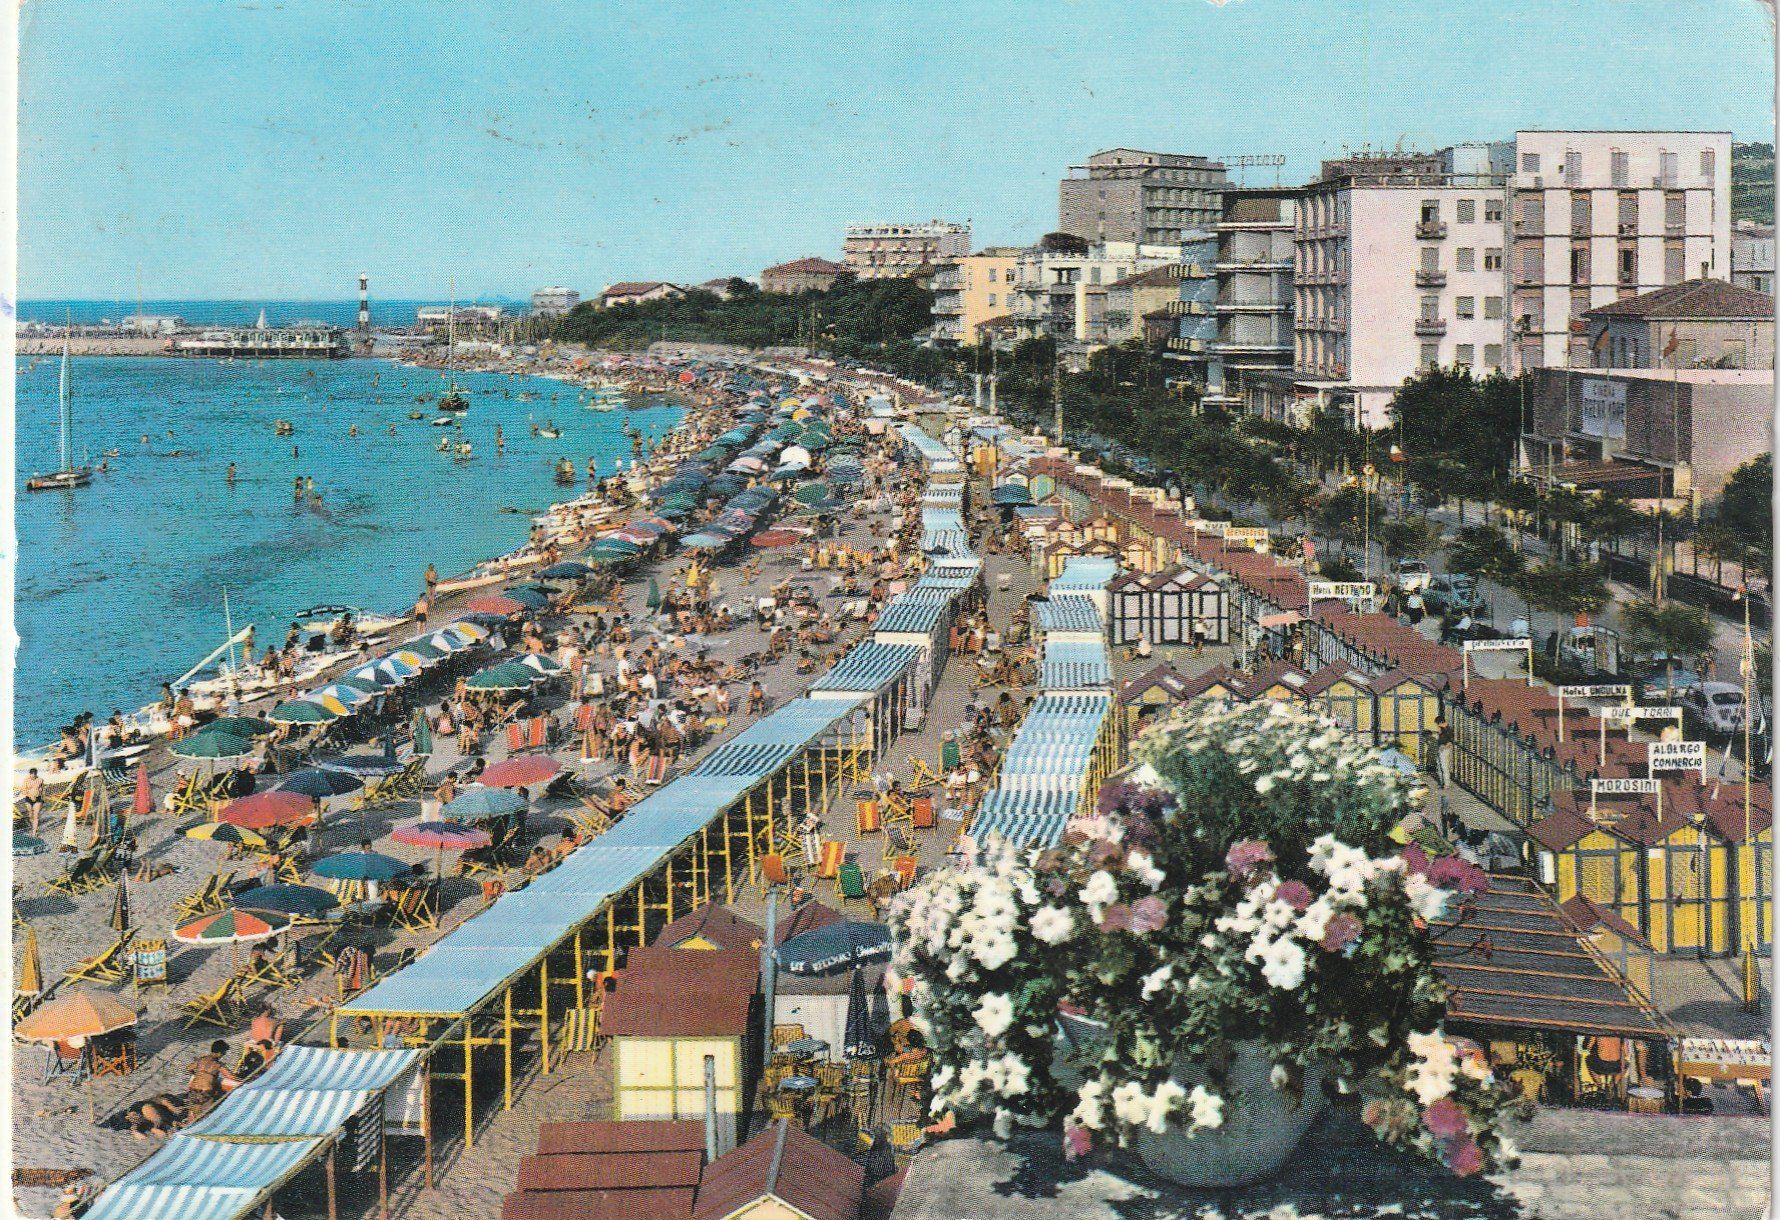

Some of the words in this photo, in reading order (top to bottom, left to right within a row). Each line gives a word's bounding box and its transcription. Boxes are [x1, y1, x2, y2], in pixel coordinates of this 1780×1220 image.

[1611, 707, 1631, 718] DUE
[1653, 743, 1700, 755] ALBERGO
[1653, 757, 1703, 769] COMMERCIO
[1596, 779, 1659, 792] MOROSINI
